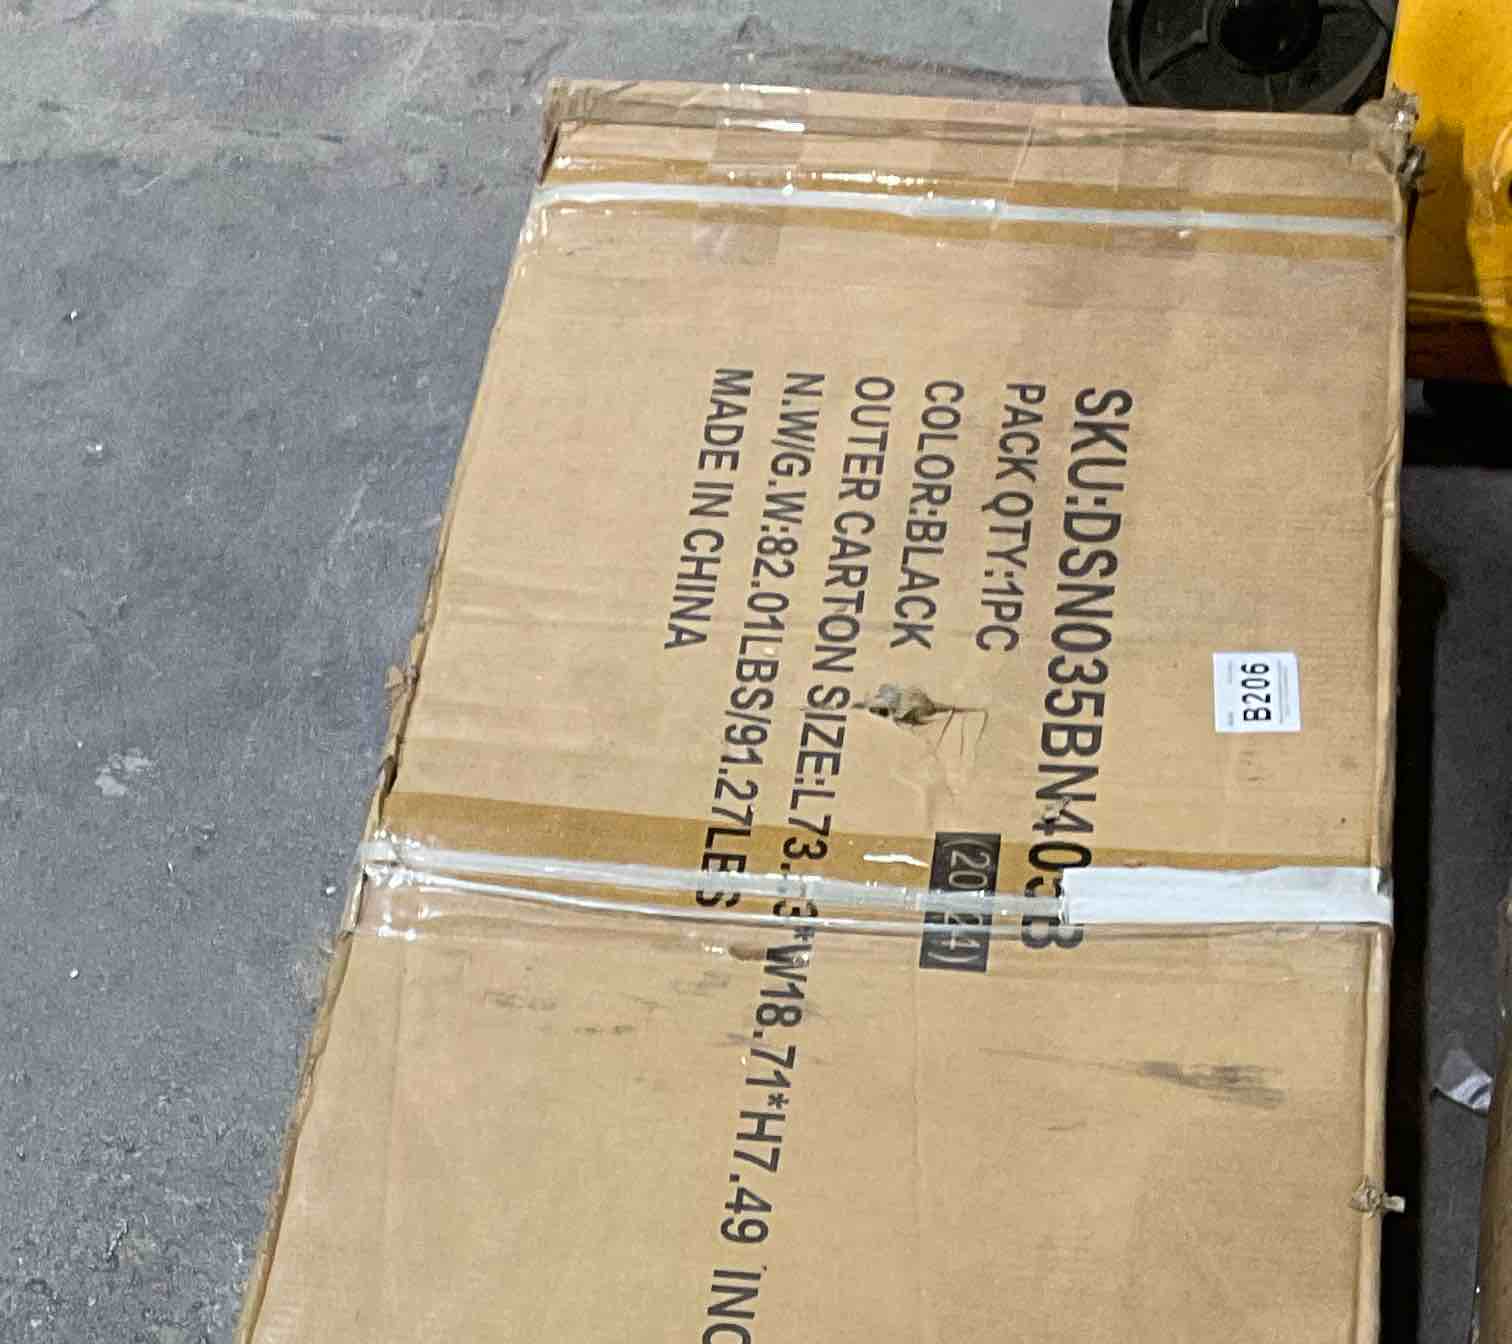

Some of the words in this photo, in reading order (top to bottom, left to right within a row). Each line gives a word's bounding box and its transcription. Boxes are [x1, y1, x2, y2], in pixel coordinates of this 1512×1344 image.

[698, 368, 754, 471] MADE
[838, 376, 896, 500] OUTER
[995, 383, 1046, 483] PACK
[688, 481, 734, 518] IN
[890, 380, 965, 650] COLOR:BLACK
[664, 528, 724, 650] CHINA
[812, 511, 876, 672] CARTON
[975, 491, 1034, 652] QTY:1PC
[1240, 663, 1271, 721] B206
